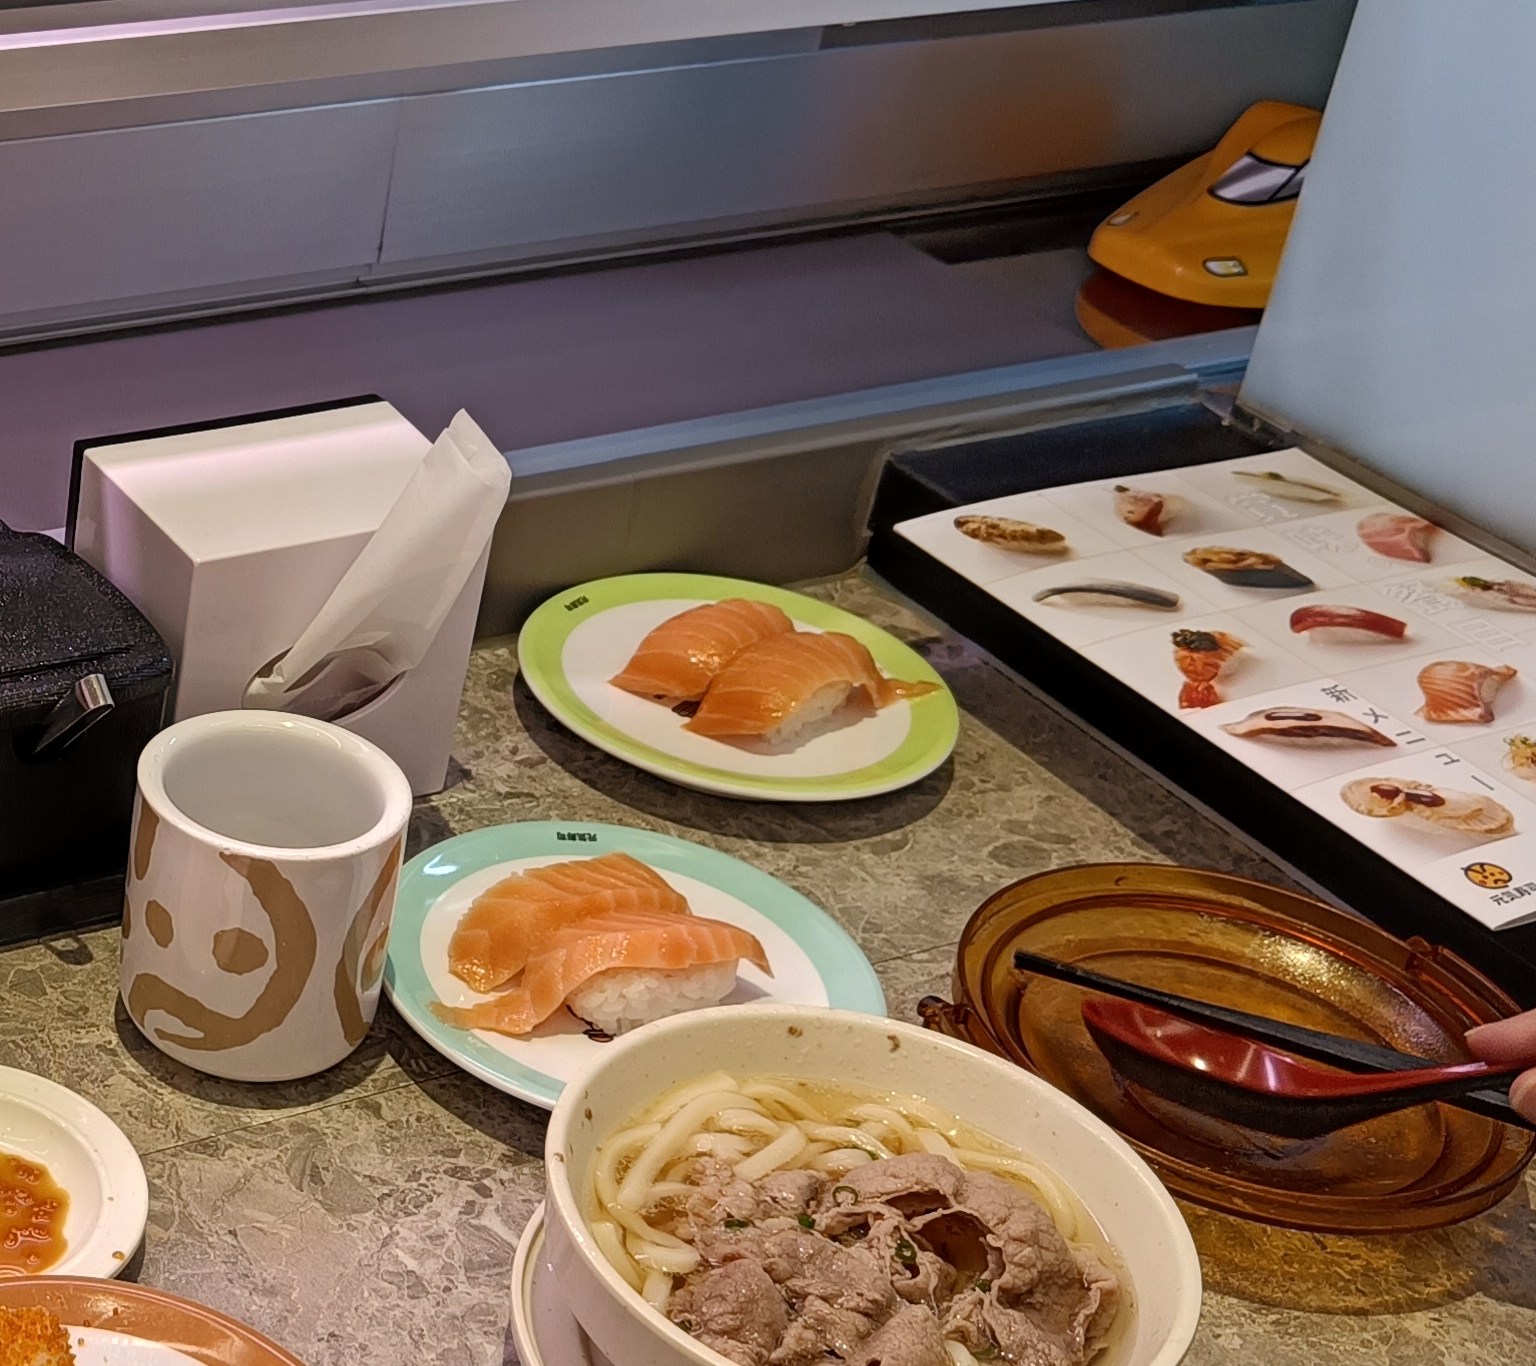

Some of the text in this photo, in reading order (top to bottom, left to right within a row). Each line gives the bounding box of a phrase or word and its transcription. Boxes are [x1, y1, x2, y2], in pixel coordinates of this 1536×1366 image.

[1320, 684, 1495, 792] 新メニュー
